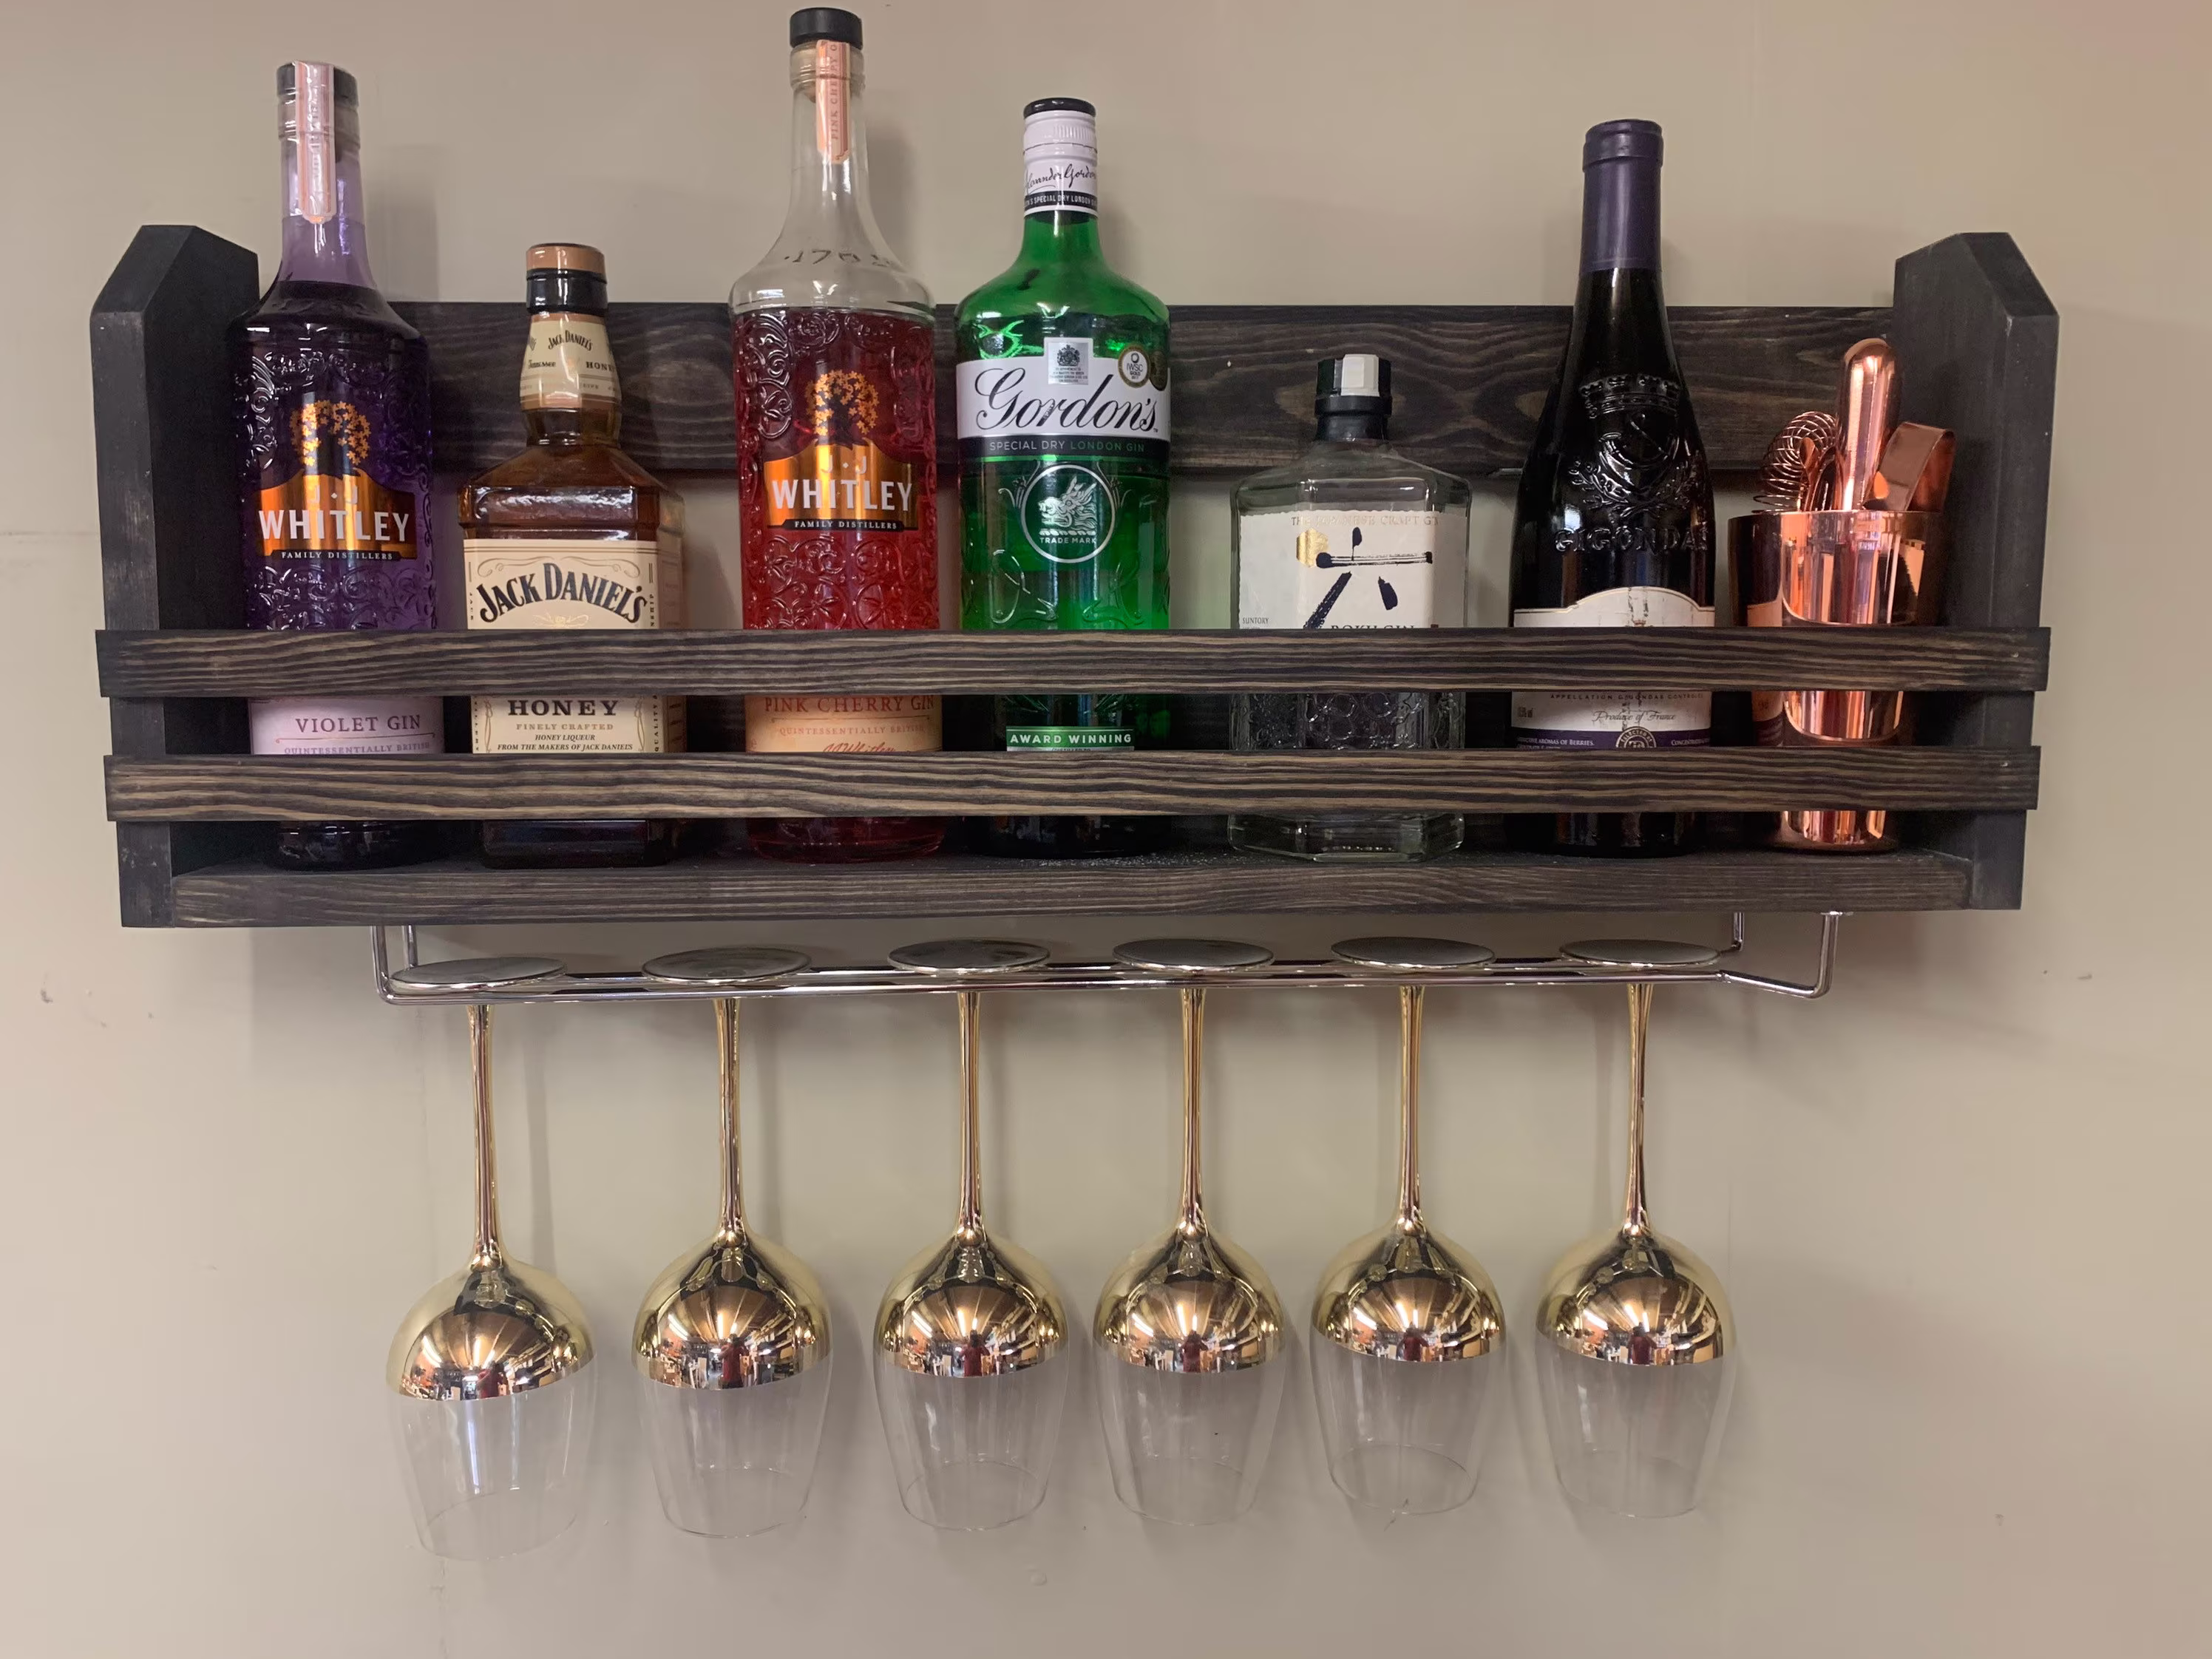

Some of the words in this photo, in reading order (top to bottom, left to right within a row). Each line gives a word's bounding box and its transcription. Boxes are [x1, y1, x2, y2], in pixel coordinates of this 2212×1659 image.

[1034, 194, 1056, 204] SPECIAL
[974, 367, 1157, 432] Gordon's
[990, 441, 1037, 451] SPECIAL
[1042, 441, 1065, 450] DRY
[1071, 441, 1122, 452] LONDON
[1126, 443, 1144, 452] GIN
[772, 478, 912, 512] WHITLEY
[258, 509, 409, 542] WHITLEY
[795, 520, 833, 529] FAMILY
[838, 520, 897, 530] DISTILLERS
[1380, 515, 1420, 526] CRAFT
[281, 551, 322, 560] FAMILY
[328, 551, 393, 560] DISTILLERS
[476, 572, 543, 623] JACK
[543, 563, 648, 624] DANIEL'S
[1242, 617, 1269, 625] SUNTORY
[508, 699, 619, 716] HONEY
[764, 697, 808, 713] PINK
[817, 696, 905, 713] CHERRY
[910, 695, 935, 710] GIN
[1592, 710, 1633, 722] Produce
[1635, 712, 1643, 722] of
[1646, 710, 1676, 721] France
[295, 716, 379, 733] VIOLET
[387, 715, 421, 730] GIN
[779, 727, 887, 736] QUINTESSENTIALLY
[562, 734, 596, 742] LIQUEUR
[1010, 734, 1062, 744] AWARD
[1068, 733, 1132, 744] WINNING
[284, 744, 392, 754] QUINTESSENTIALLY
[396, 742, 430, 751] BRITISH
[581, 744, 600, 752] JACK
